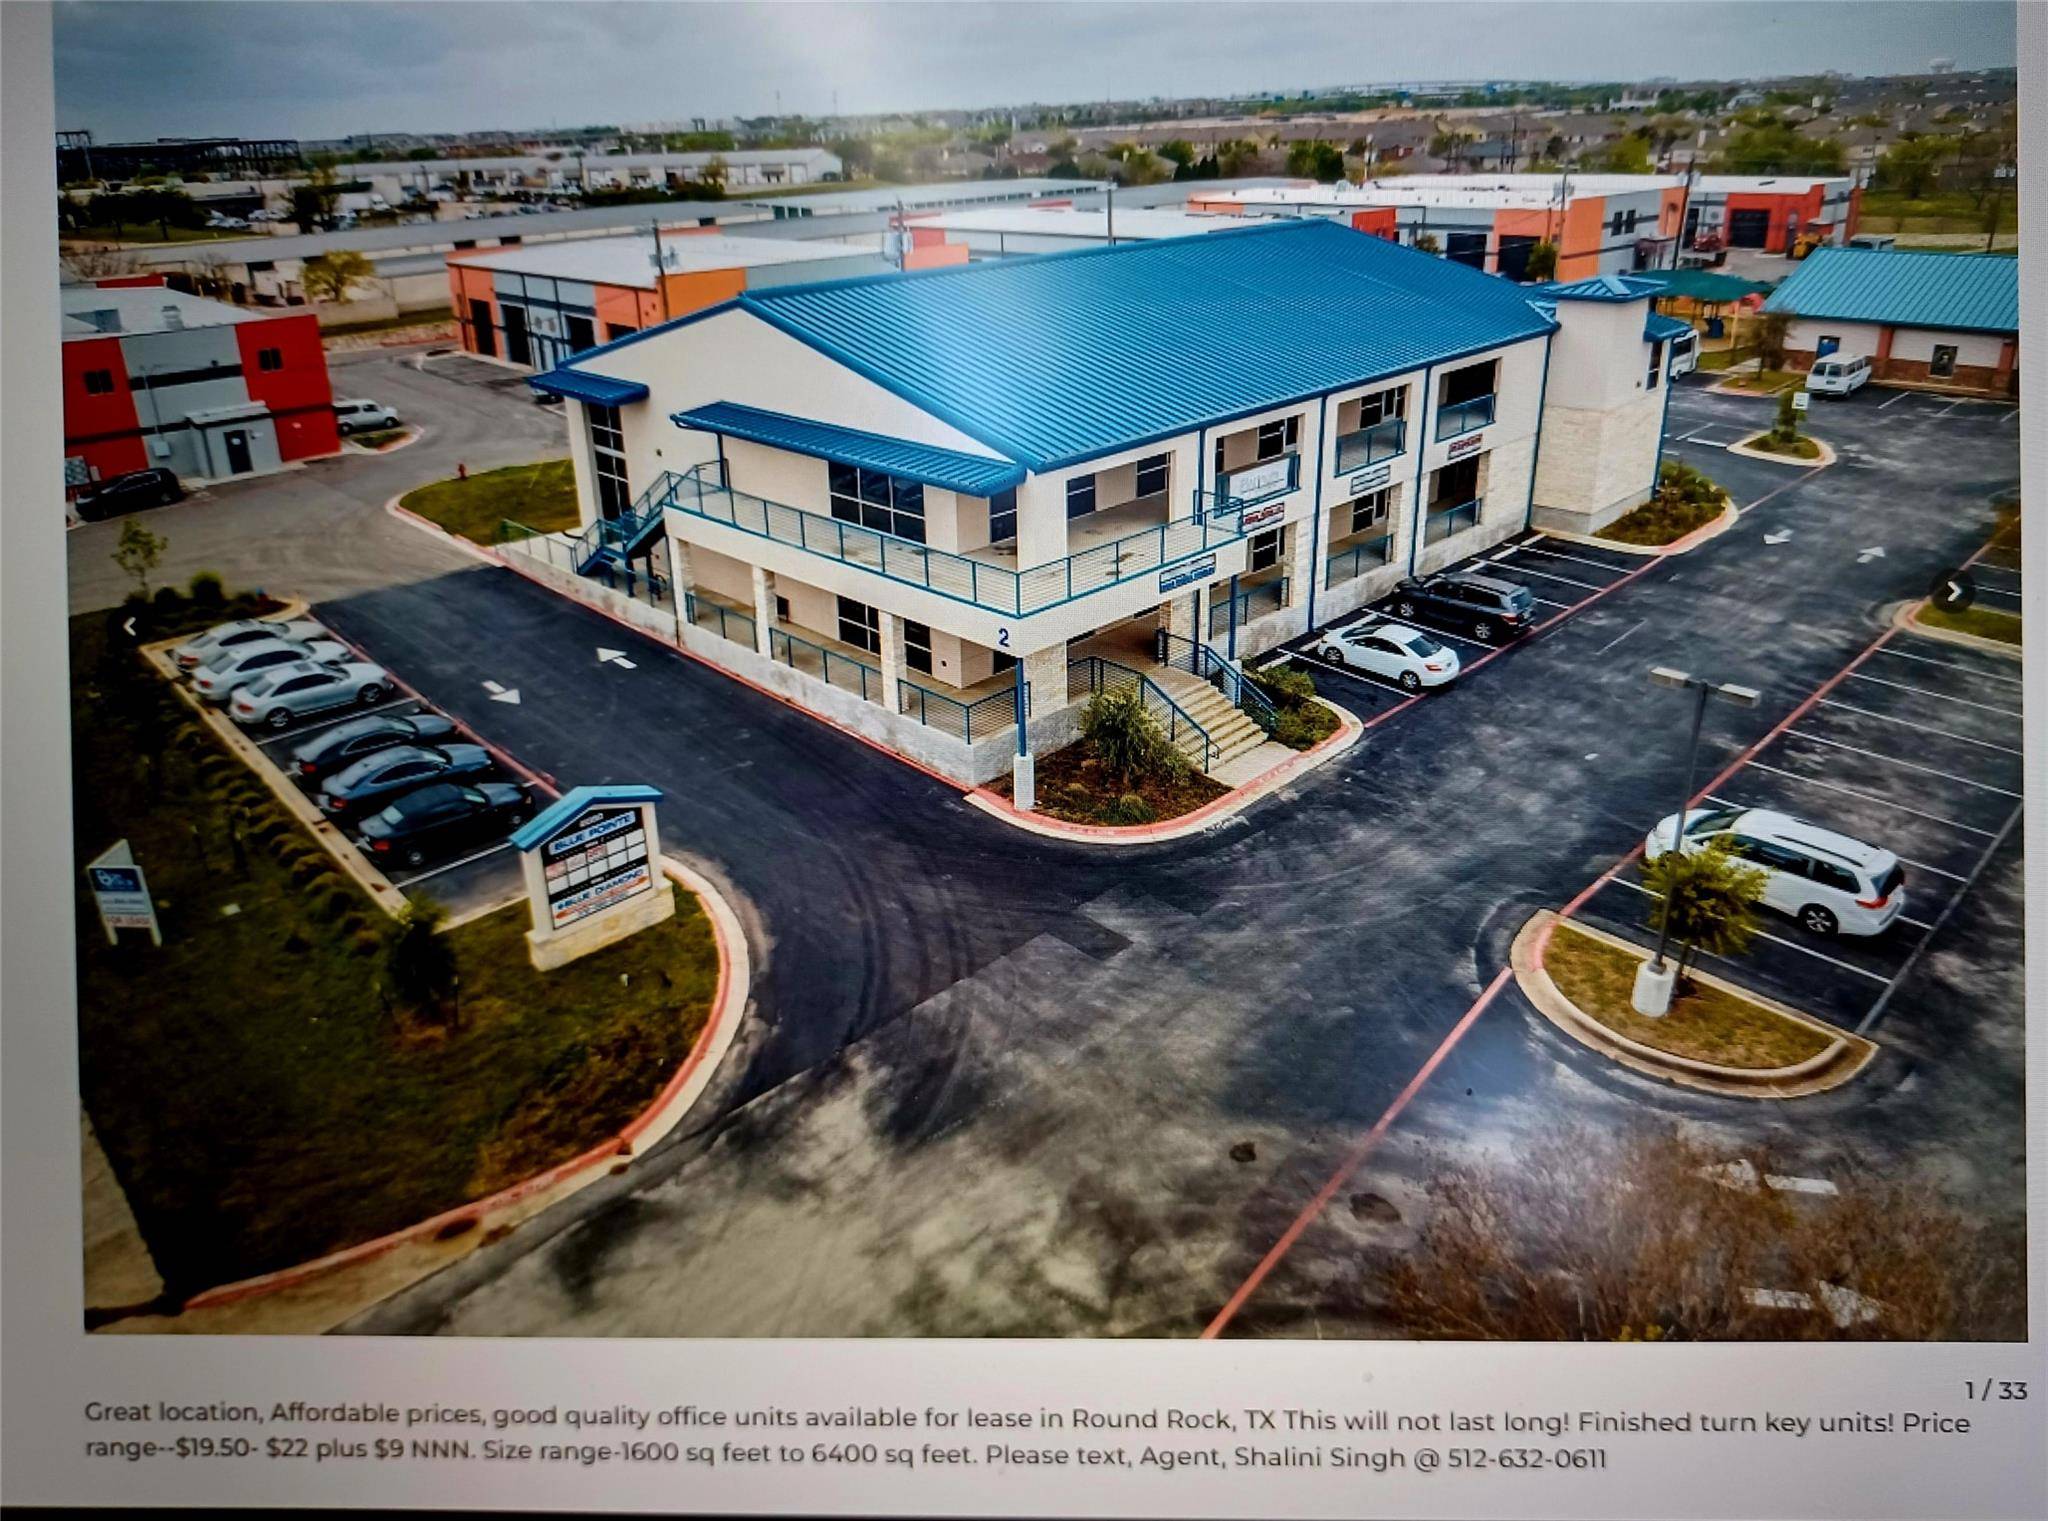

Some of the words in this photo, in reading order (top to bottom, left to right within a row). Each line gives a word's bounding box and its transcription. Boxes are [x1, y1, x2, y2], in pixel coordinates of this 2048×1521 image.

[999, 627, 1010, 647] 2
[1964, 1380, 1974, 1400] 1
[1998, 1381, 2028, 1401] 33
[84, 1401, 152, 1422] Great
[159, 1401, 265, 1425] location,
[269, 1401, 401, 1423] Affordable
[405, 1402, 487, 1428] prices,
[491, 1405, 558, 1430] good
[564, 1404, 651, 1431] quality
[656, 1405, 728, 1427] office
[734, 1405, 799, 1428] units
[805, 1405, 918, 1428] available
[923, 1406, 960, 1428] for
[967, 1407, 1033, 1428] lease
[1039, 1406, 1064, 1429] in
[1072, 1408, 1159, 1430] Round
[1167, 1408, 1237, 1433] Rock,
[1243, 1409, 1277, 1430] TX
[1282, 1408, 1337, 1431] This
[1343, 1409, 1389, 1431] will
[1397, 1413, 1442, 1432] not
[1450, 1410, 1496, 1432] last
[1504, 1410, 1570, 1438] long!
[1578, 1410, 1693, 1433] Finished
[1699, 1414, 1757, 1433] turn
[1765, 1411, 1812, 1438] key
[1819, 1411, 1894, 1433] units!
[1903, 1411, 1972, 1434] Price
[85, 1436, 259, 1462] range--$19.50-
[265, 1436, 309, 1459] $22
[315, 1438, 368, 1463] plus
[373, 1437, 405, 1461] $9
[411, 1439, 477, 1460] NNN.
[482, 1439, 533, 1461] Size
[539, 1441, 680, 1467] range-1600
[685, 1446, 715, 1468] sq
[721, 1441, 772, 1463] feet
[778, 1445, 805, 1464] to
[811, 1443, 878, 1465] 6400
[884, 1448, 914, 1470] sq
[921, 1443, 978, 1465] feet.
[986, 1444, 1070, 1465] Please
[1076, 1447, 1133, 1469] text,
[1139, 1445, 1227, 1471] Agent,
[1234, 1445, 1322, 1467] Shalini
[1329, 1446, 1407, 1473] Singh
[1413, 1447, 1442, 1474] @
[1448, 1447, 1607, 1470] 512-632-0611
